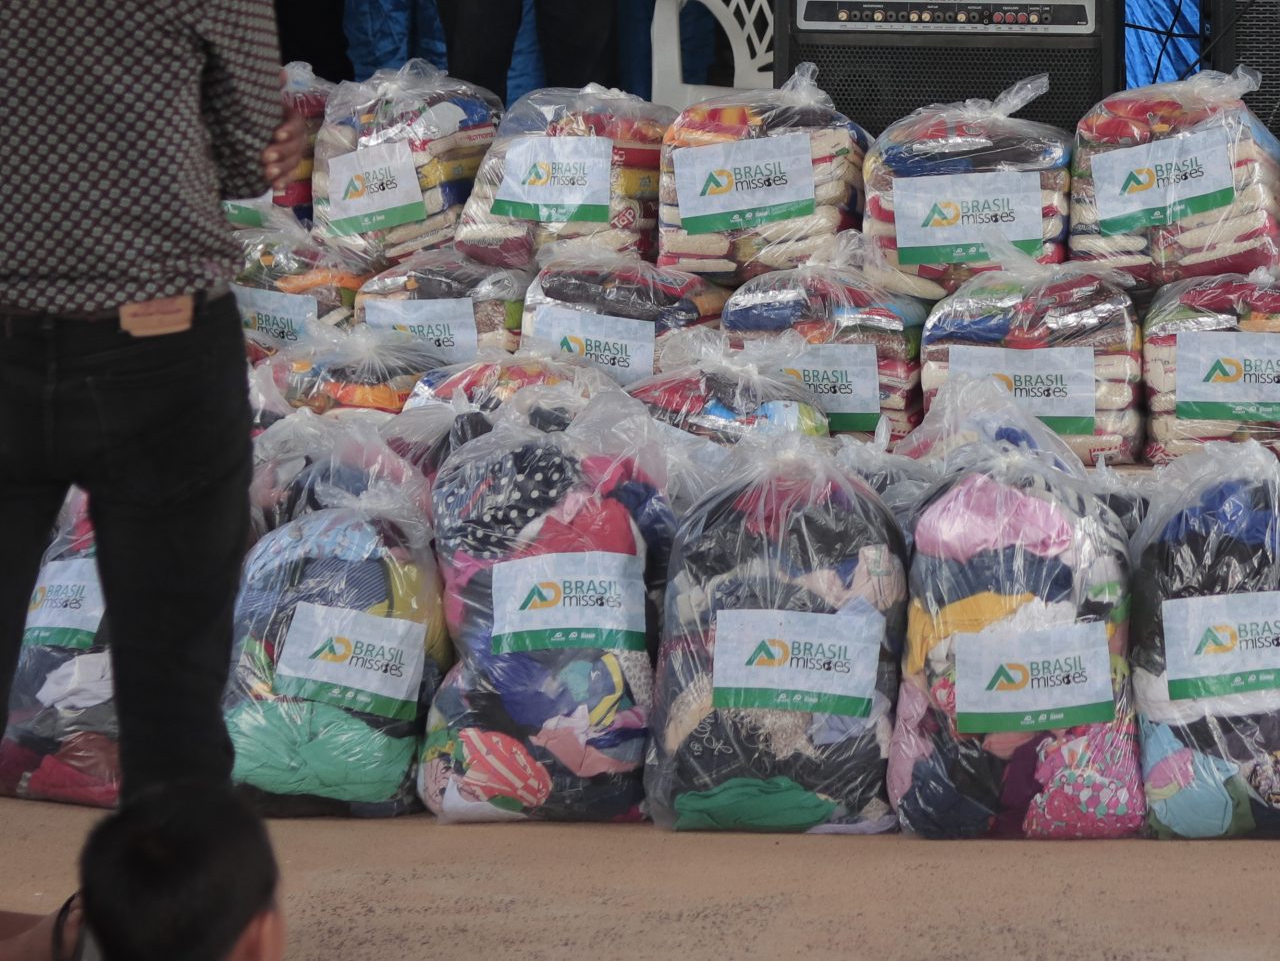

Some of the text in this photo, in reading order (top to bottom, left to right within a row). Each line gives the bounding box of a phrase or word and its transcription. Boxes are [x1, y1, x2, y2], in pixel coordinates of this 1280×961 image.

[364, 166, 395, 185] RASIL
[551, 163, 587, 175] BRASIL
[734, 161, 786, 180] BRASIL
[961, 198, 1013, 214] BRASIL
[257, 313, 295, 330] BRASIL
[585, 339, 630, 355] BRASIL
[803, 369, 853, 383] BRASIL
[1014, 374, 1067, 387] BRASIL
[45, 585, 86, 598] BRASIL
[563, 580, 620, 596] BRASIL
[352, 640, 405, 666] BRASIL
[791, 641, 851, 661] BRASIL
[1030, 655, 1085, 675] BRASIL
